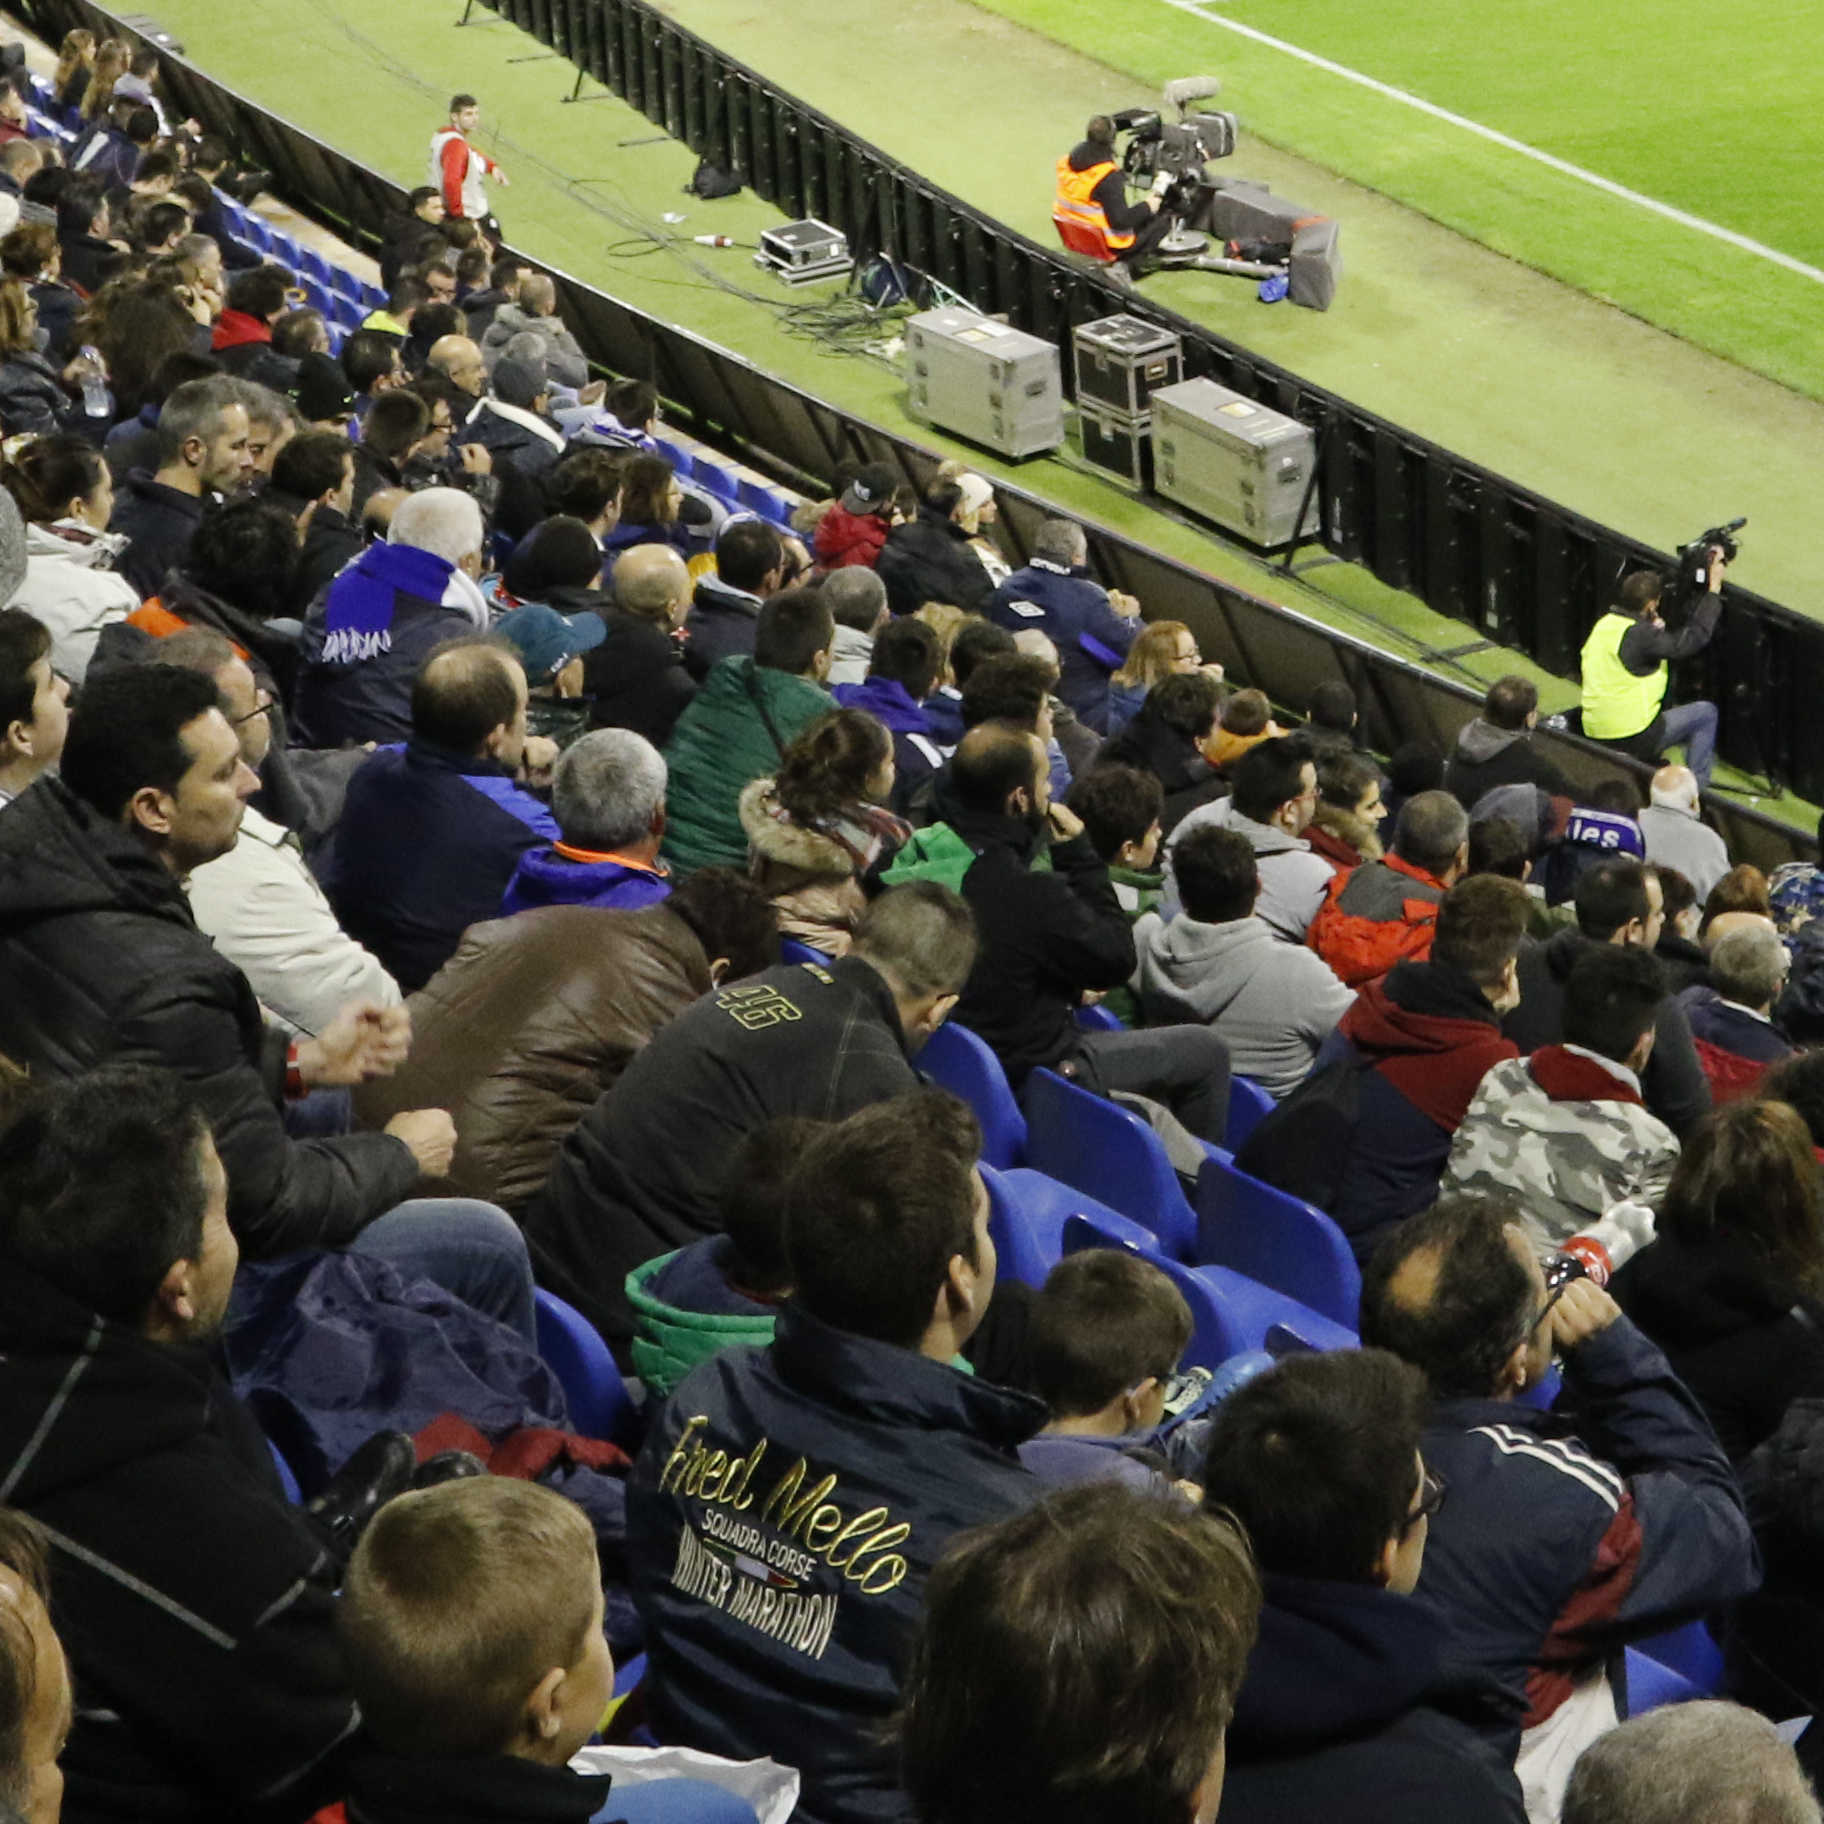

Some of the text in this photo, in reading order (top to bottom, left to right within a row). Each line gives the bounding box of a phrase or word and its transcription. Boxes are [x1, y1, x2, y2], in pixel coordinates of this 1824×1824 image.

[715, 984, 803, 1030] 46
[658, 1414, 912, 1595] Fred Mello
[701, 1508, 819, 1582] SQUADRA CORSE
[671, 1523, 840, 1662] WINTER MARATHON
